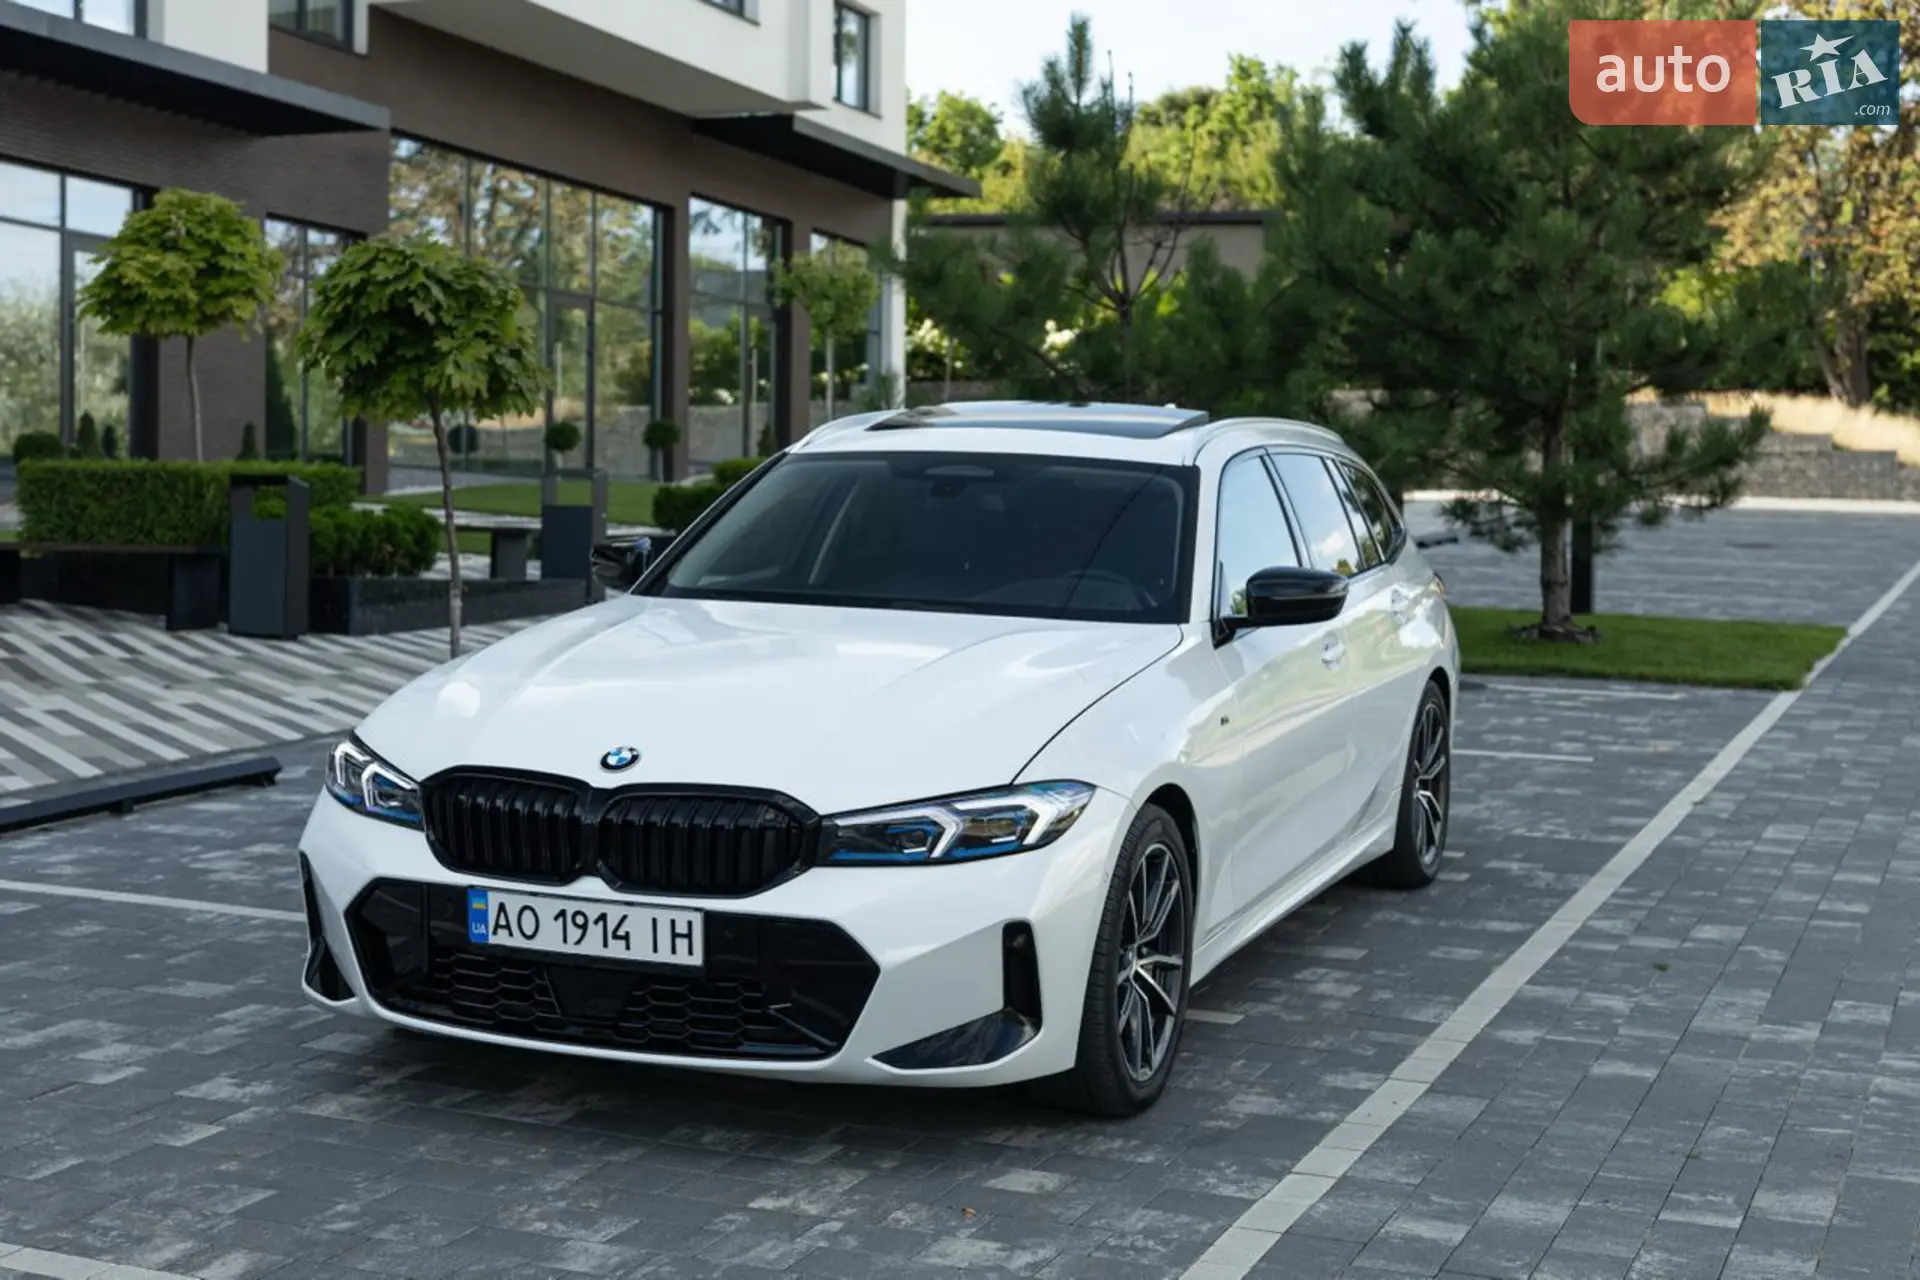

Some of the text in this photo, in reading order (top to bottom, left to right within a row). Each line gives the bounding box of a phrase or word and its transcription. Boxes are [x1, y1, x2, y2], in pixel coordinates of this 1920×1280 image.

[472, 923, 487, 935] UA
[491, 901, 694, 956] AO 1914 IH
